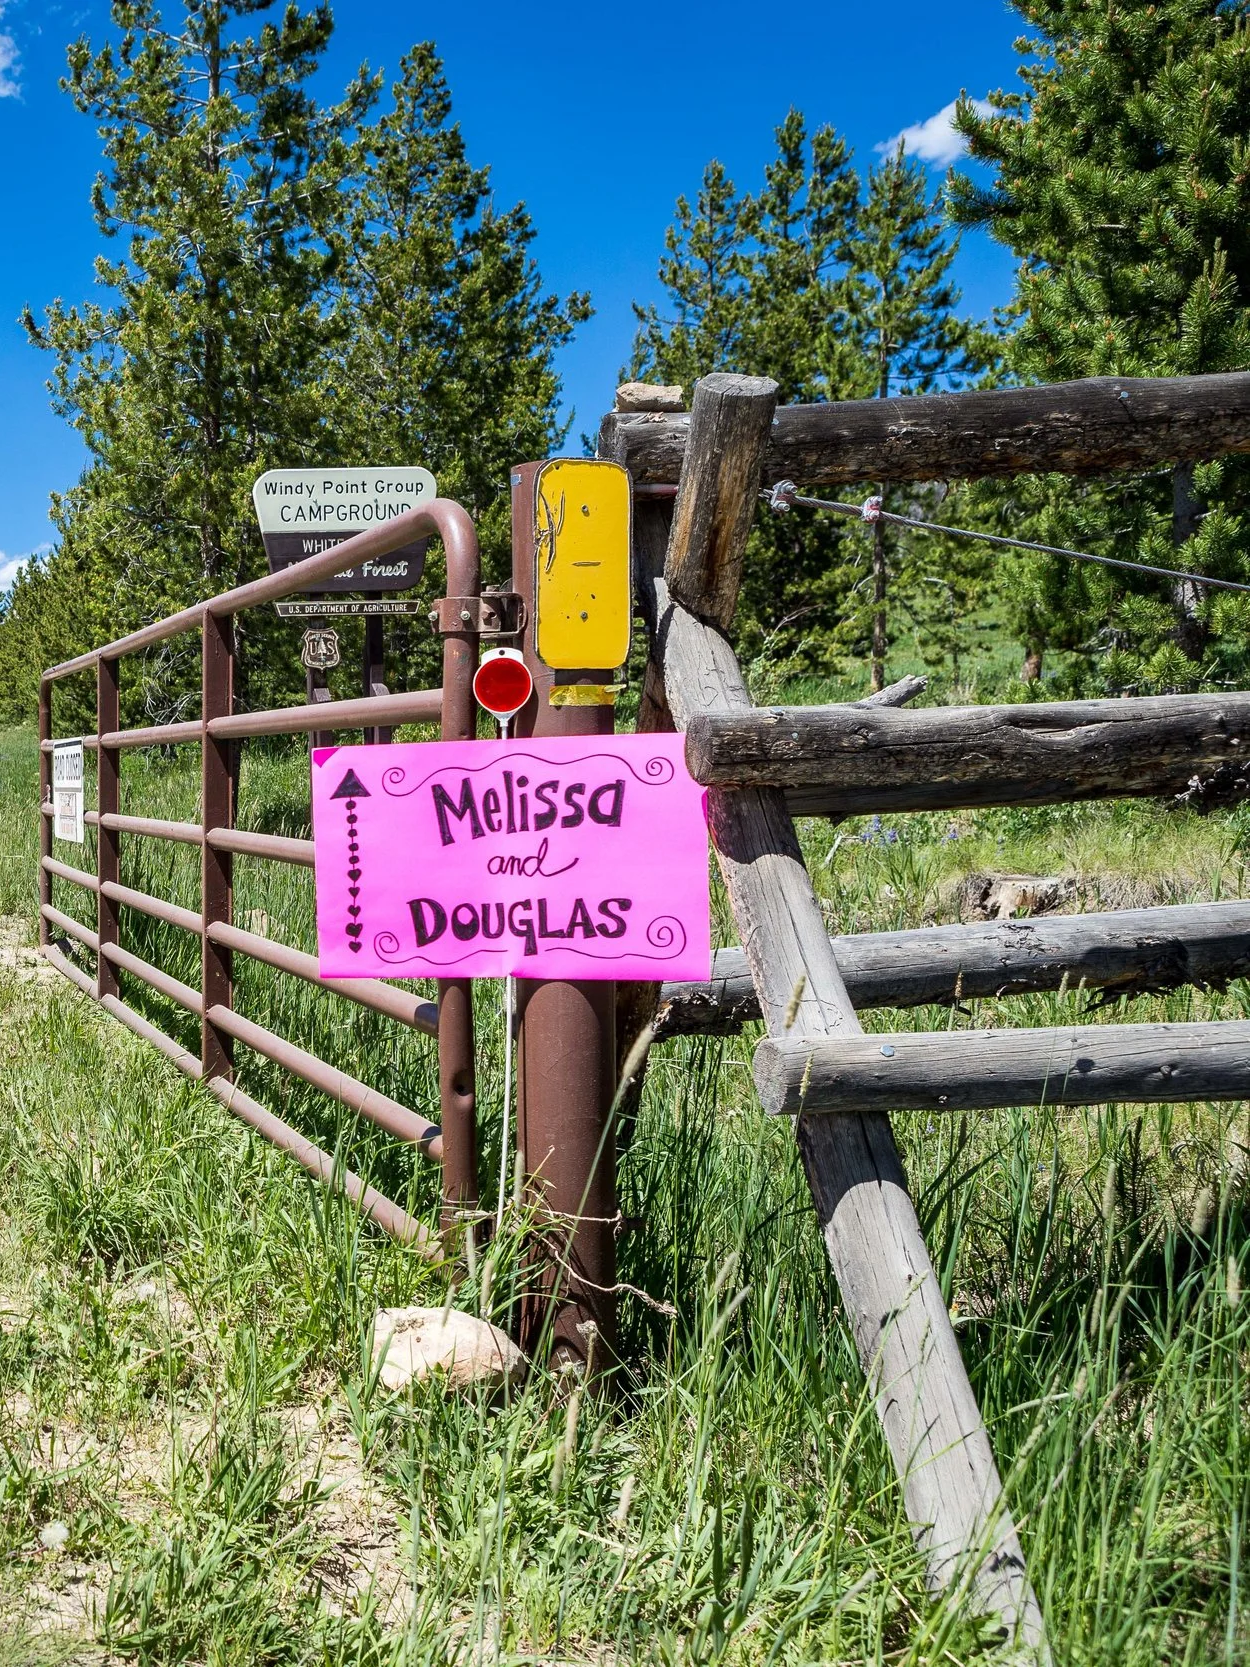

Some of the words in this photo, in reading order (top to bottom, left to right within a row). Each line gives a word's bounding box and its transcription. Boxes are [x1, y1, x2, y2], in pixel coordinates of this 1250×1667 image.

[264, 481, 315, 498] Windy
[323, 480, 367, 494] Point
[374, 479, 424, 496] Group
[302, 538, 345, 553] WHIT
[361, 559, 409, 577] Forest
[288, 605, 302, 614] U.S.
[304, 604, 348, 614] DEPARTMENT
[350, 604, 360, 613] OF
[363, 603, 408, 612] AGRICULTURE
[430, 770, 626, 847] Melissa
[487, 837, 579, 878] and
[407, 897, 633, 957] DOUGLAS
